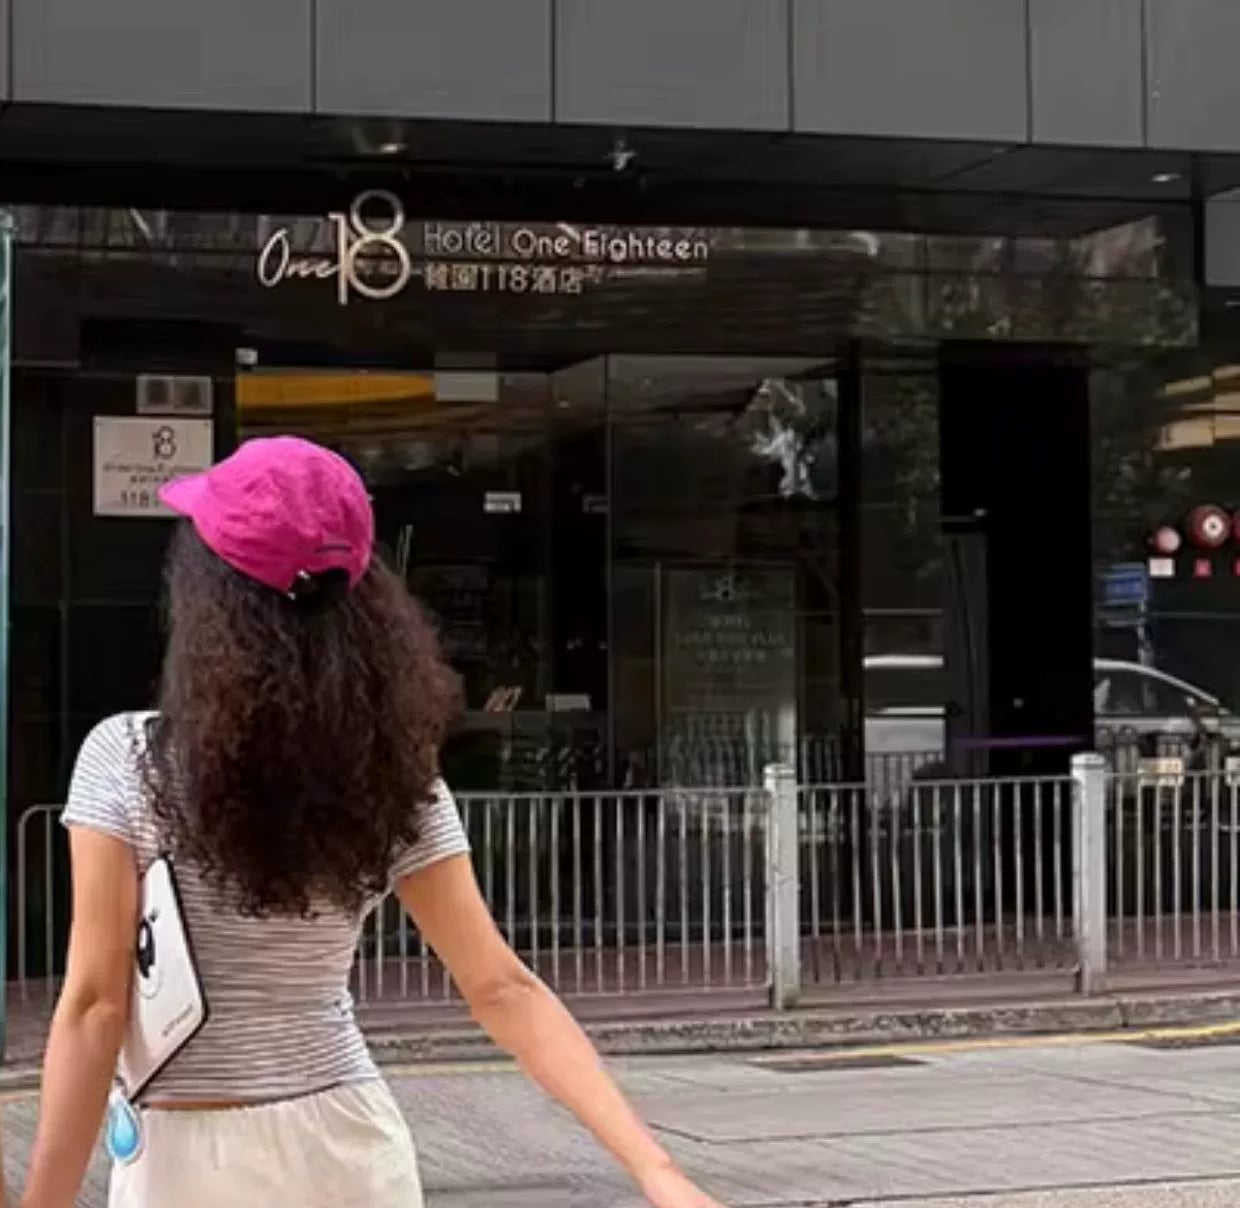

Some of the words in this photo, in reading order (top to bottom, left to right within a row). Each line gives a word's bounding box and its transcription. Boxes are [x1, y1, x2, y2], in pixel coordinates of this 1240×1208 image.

[423, 221, 501, 255] Hotel
[512, 228, 570, 256] One
[583, 229, 709, 262] Eighteen
